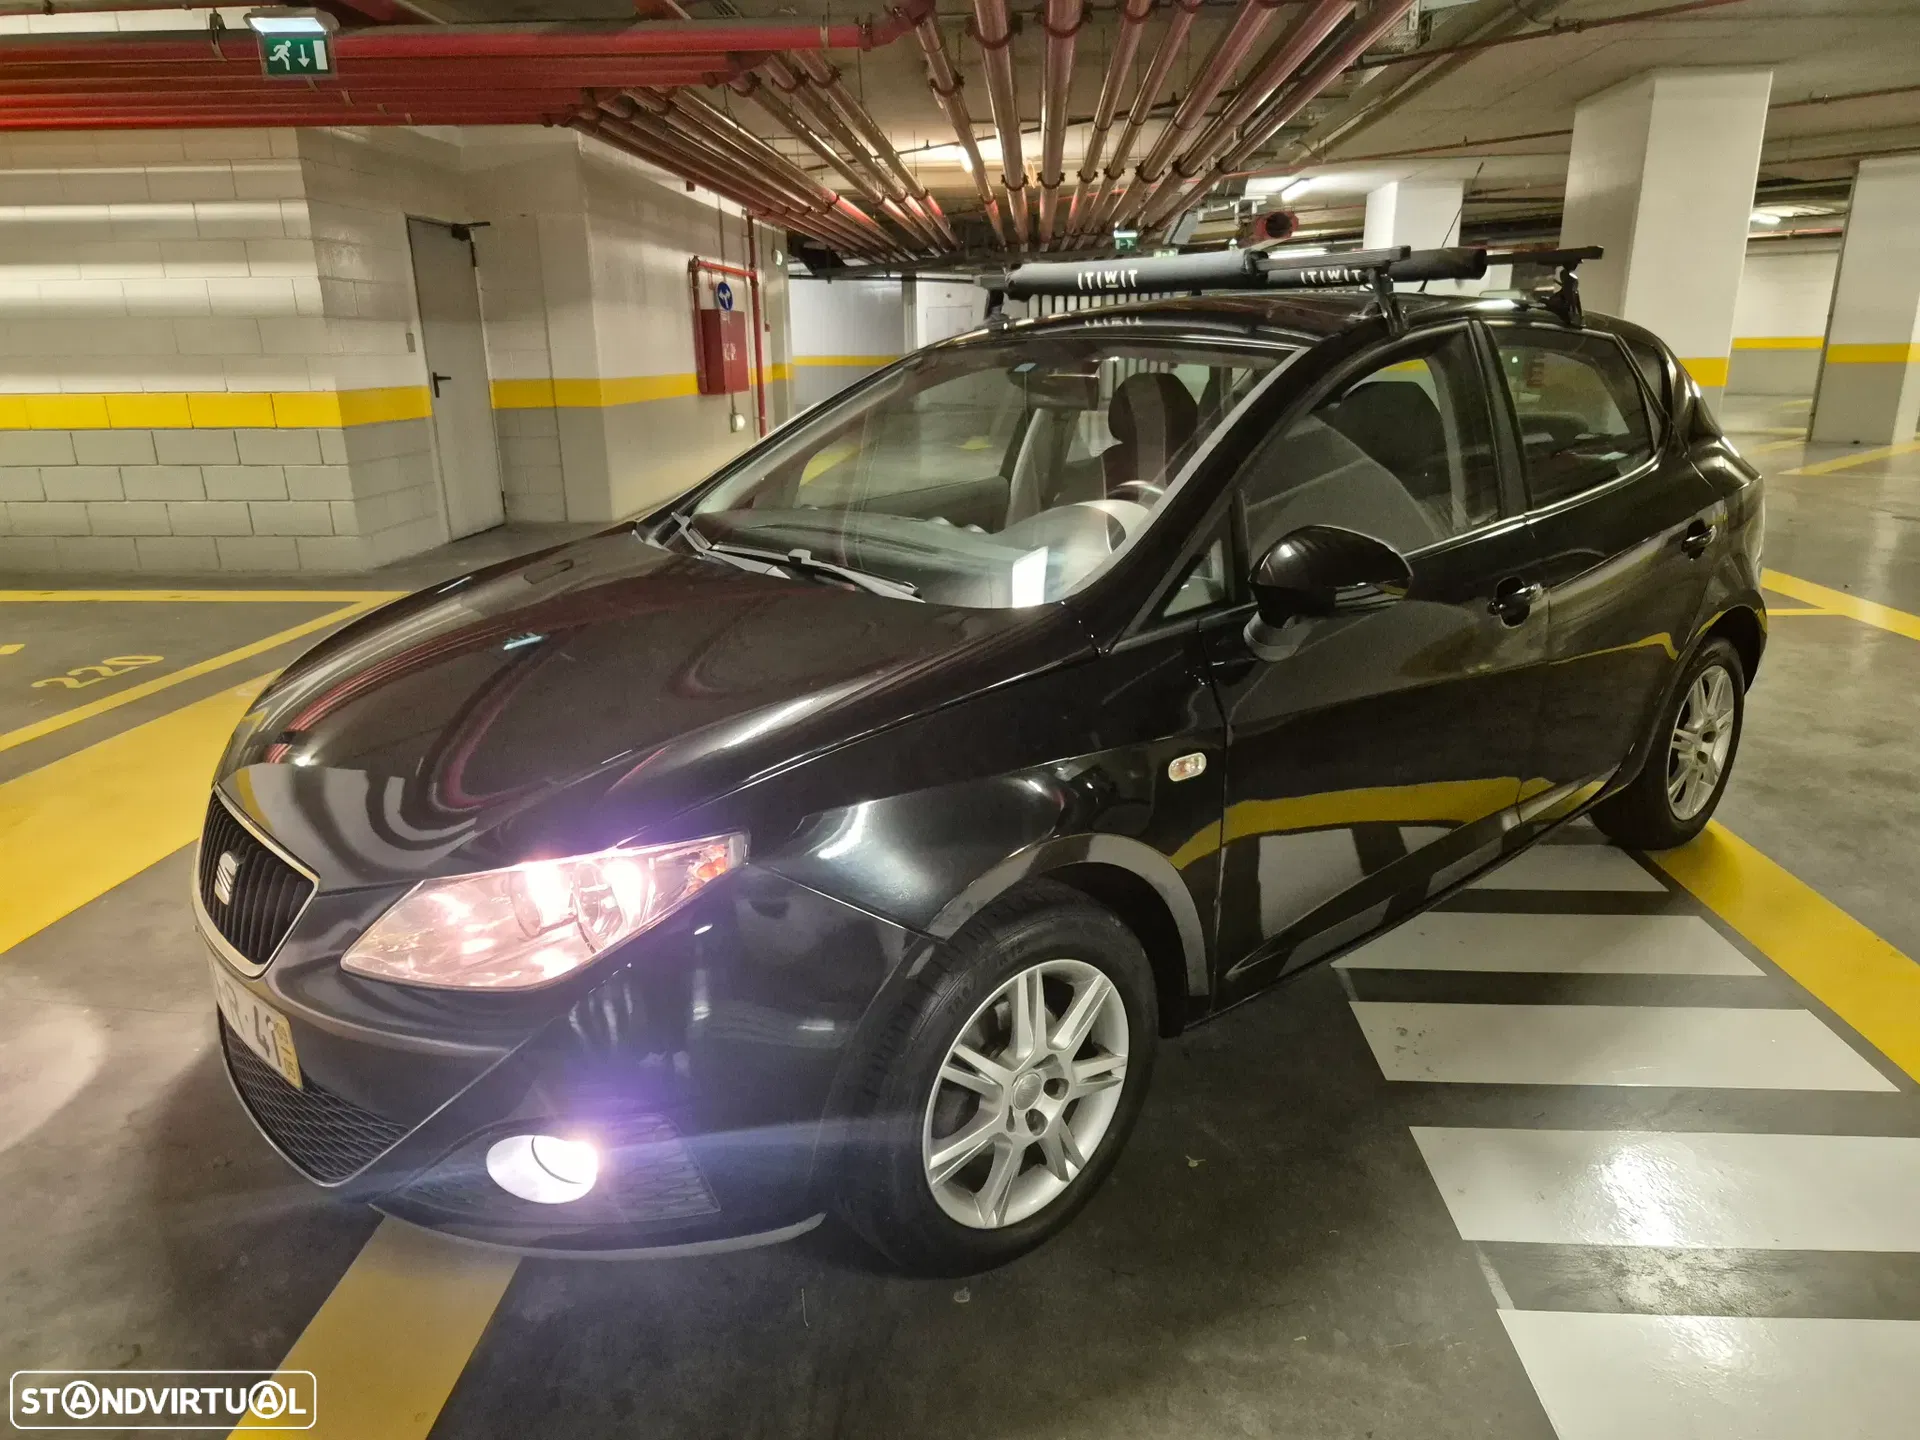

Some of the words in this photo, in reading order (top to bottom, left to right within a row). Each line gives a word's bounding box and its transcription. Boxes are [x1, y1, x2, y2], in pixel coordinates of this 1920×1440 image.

[1078, 269, 1138, 290] ITIWIT
[1300, 268, 1361, 285] ITIWIT
[31, 655, 165, 689] 220
